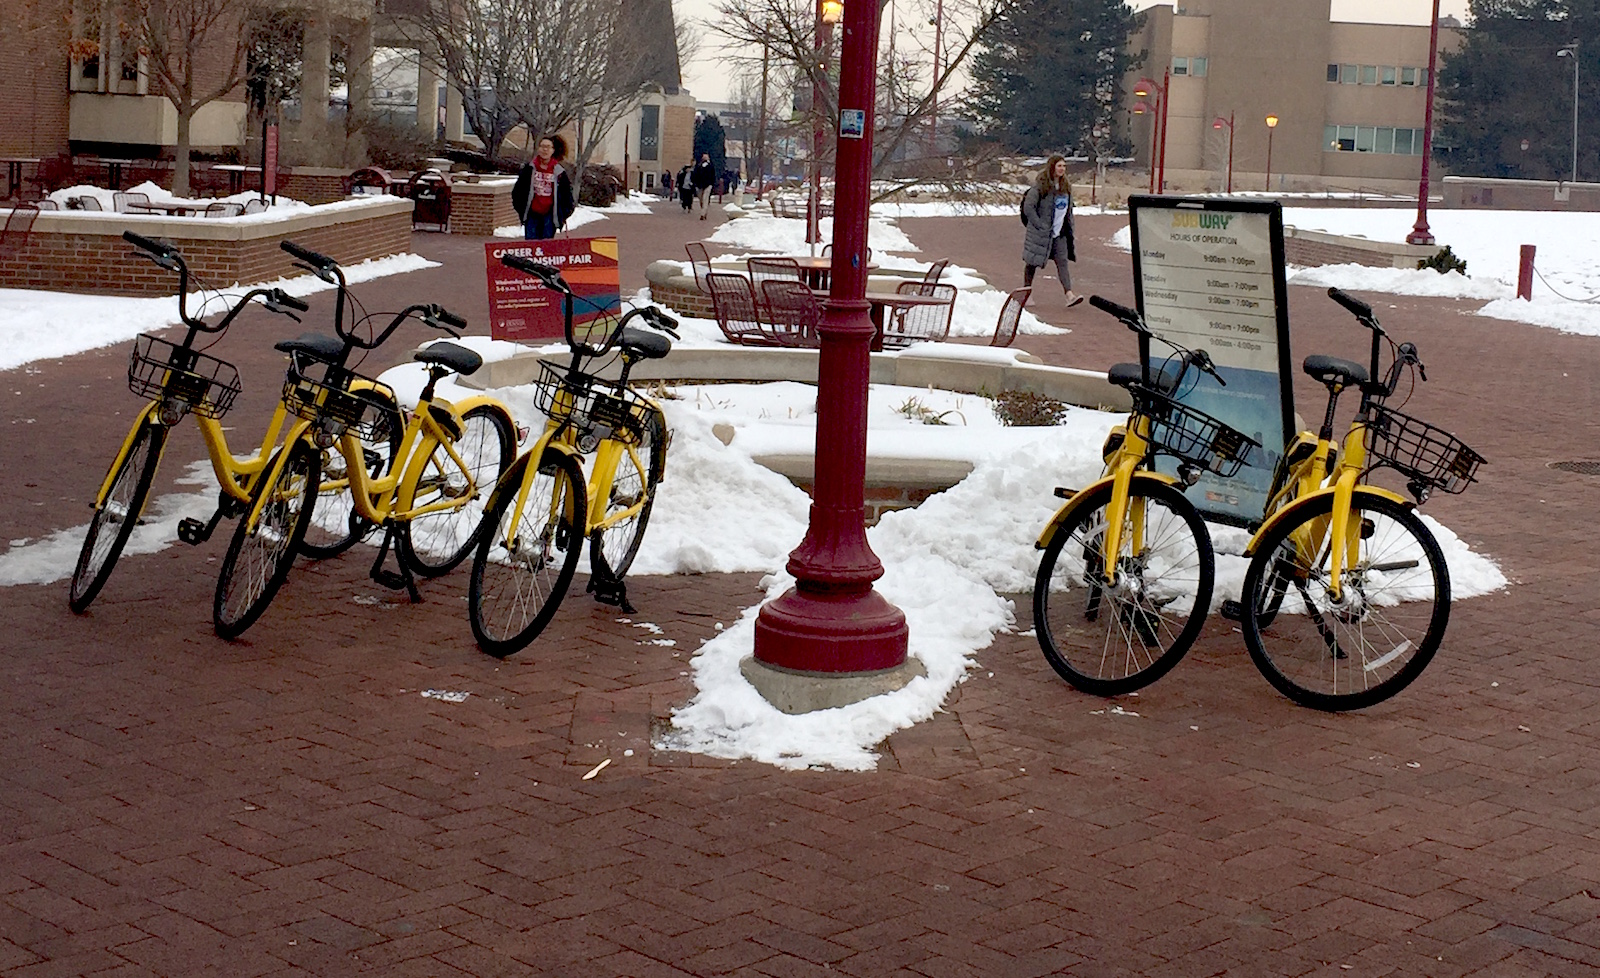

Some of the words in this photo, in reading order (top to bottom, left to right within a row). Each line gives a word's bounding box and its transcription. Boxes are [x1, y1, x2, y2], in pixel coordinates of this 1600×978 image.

[1172, 213, 1231, 229] SUBWAY
[1170, 233, 1191, 242] HOURS
[1192, 234, 1201, 243] OF
[1201, 235, 1238, 245] OPERATION
[535, 247, 544, 257] &
[569, 254, 592, 264] FAIR
[1142, 250, 1165, 260] Monday
[1204, 255, 1227, 264] 9:00am
[1231, 257, 1256, 267] 7:00pm
[1143, 273, 1167, 284] Tuesday
[1206, 279, 1230, 289] 9:00am
[1234, 281, 1259, 292] 7:00pm
[1145, 291, 1178, 302] Wednesday
[1207, 296, 1231, 305] 9:00am
[1236, 298, 1260, 308] 7:00pm
[1209, 321, 1233, 331] 9:00am
[1237, 323, 1260, 334] 7:00pm
[1209, 337, 1234, 348] 9:00am
[1237, 340, 1262, 351] 4:00pm
